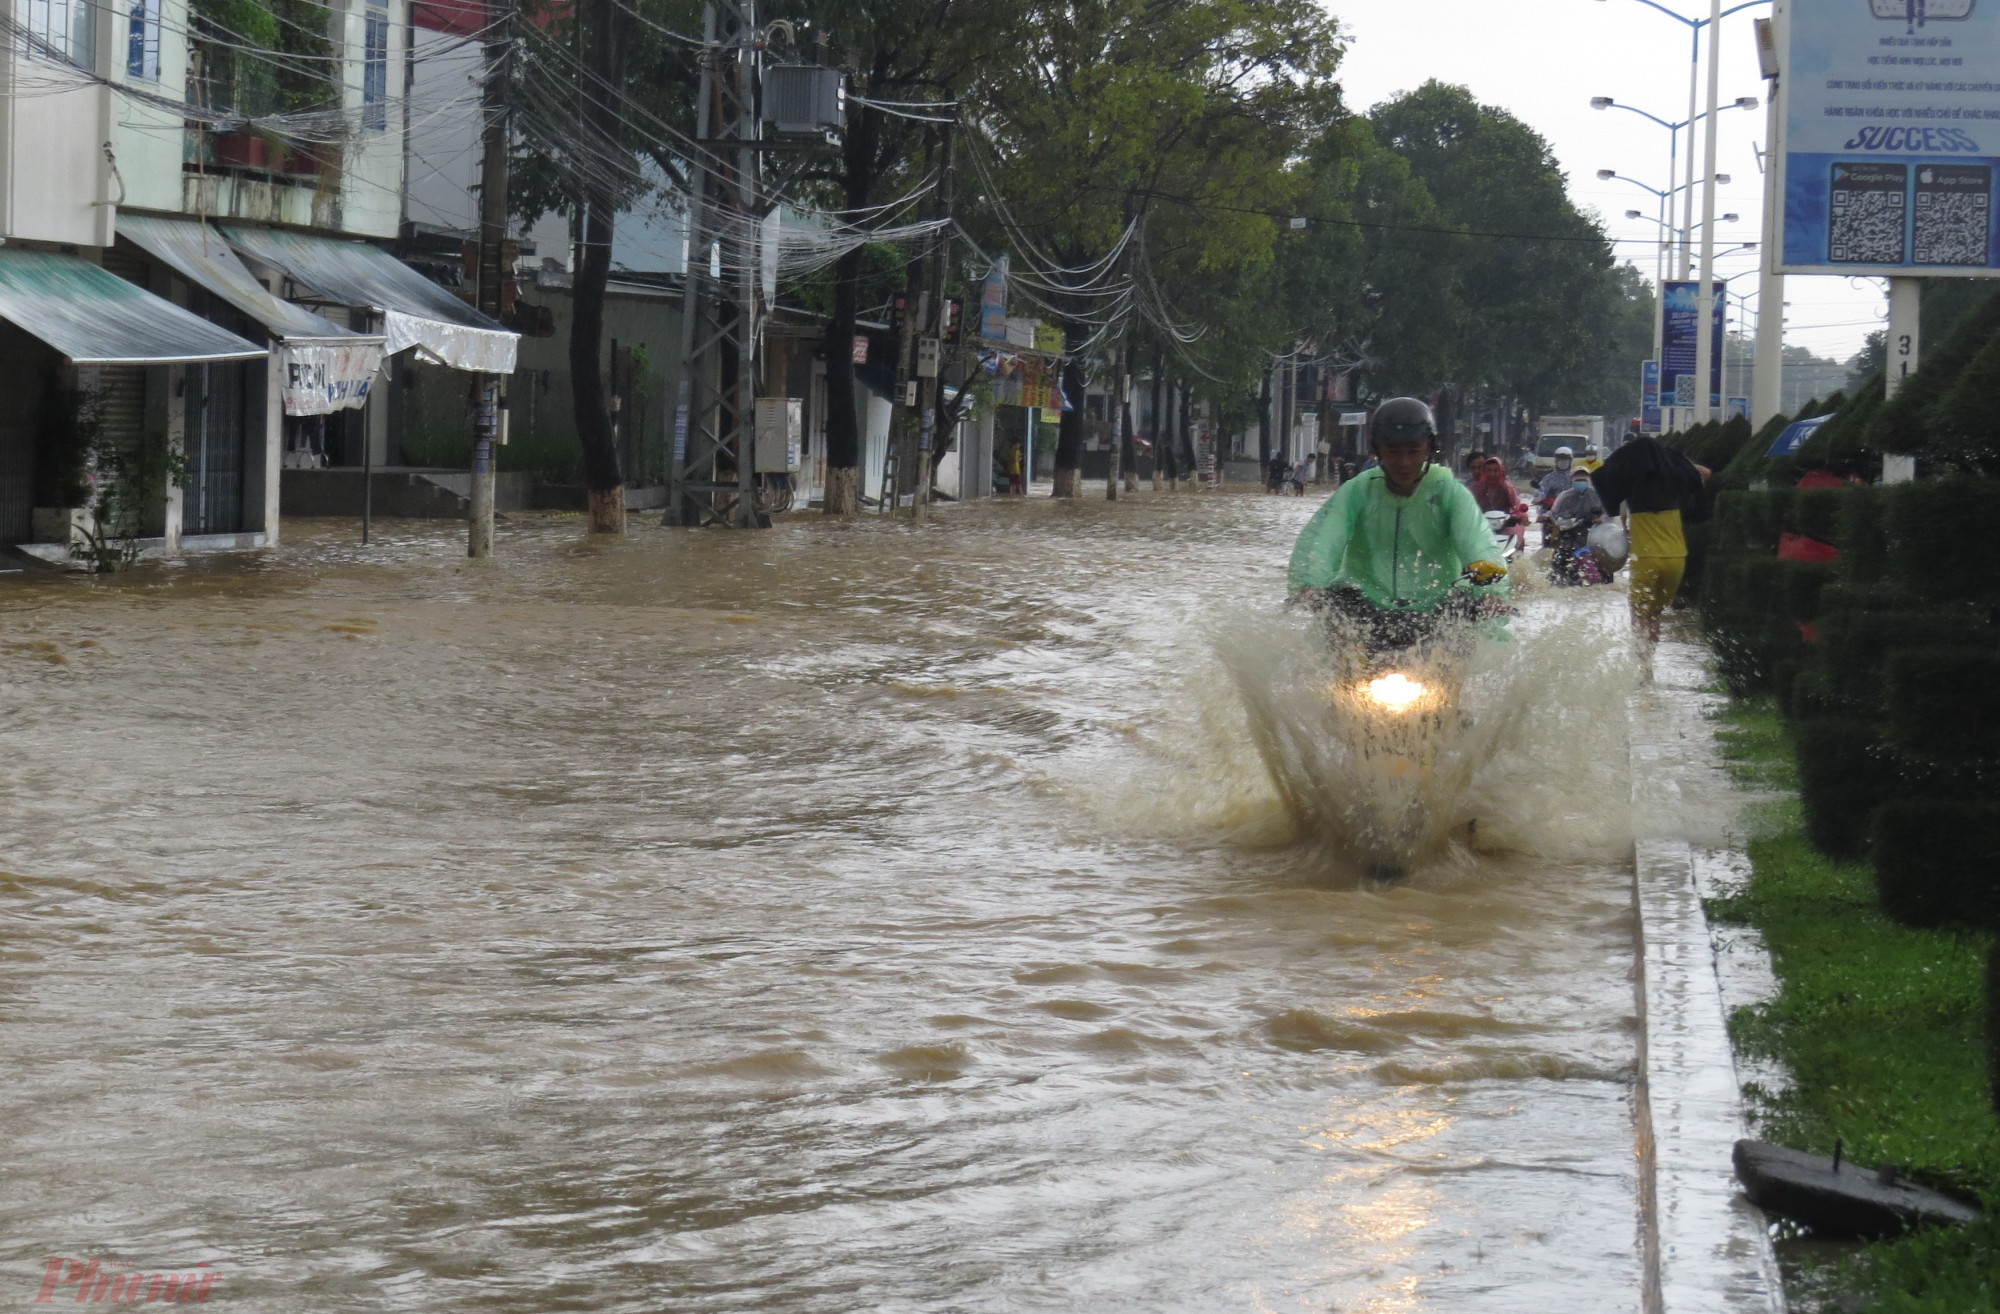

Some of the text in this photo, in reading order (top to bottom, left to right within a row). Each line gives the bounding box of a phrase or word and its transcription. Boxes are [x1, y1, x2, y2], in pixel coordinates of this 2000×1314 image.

[1844, 126, 1980, 152] SUCCESS
[1850, 172, 1906, 184] Google Play
[1936, 176, 1984, 186] App Store
